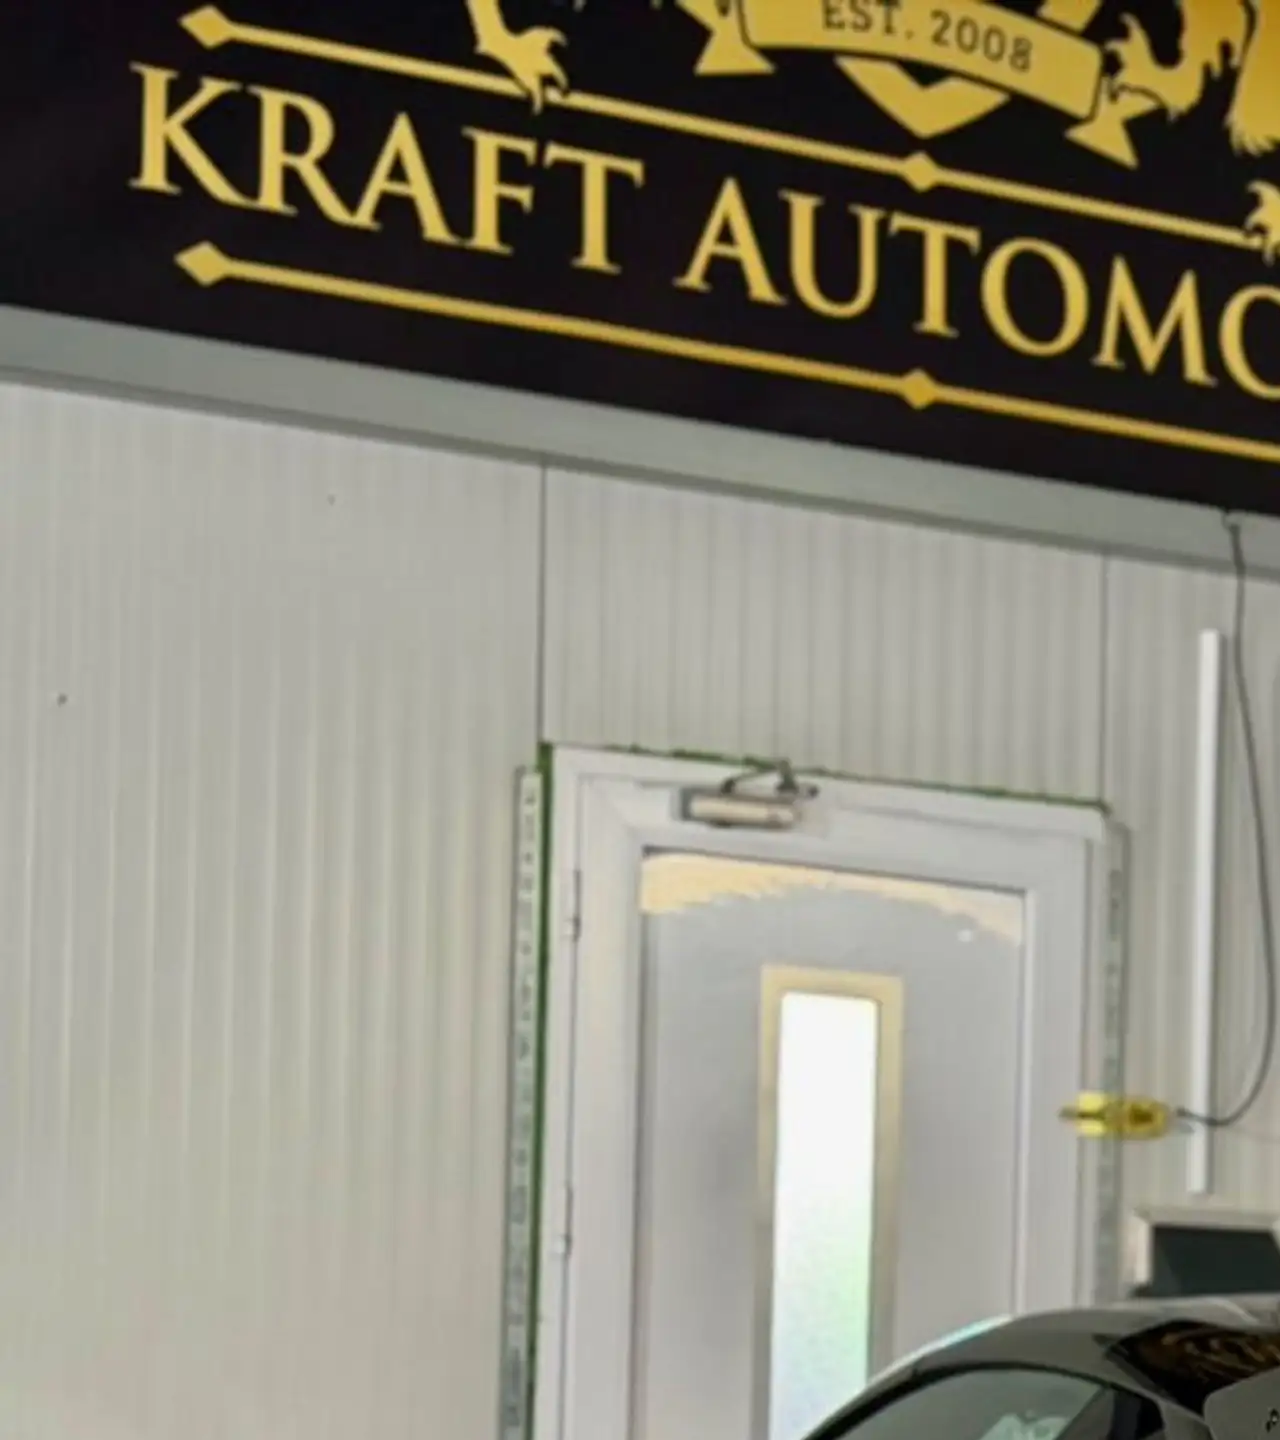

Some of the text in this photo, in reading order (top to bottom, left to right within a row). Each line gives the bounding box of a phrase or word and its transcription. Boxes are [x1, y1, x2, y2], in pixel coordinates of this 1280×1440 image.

[822, 0, 1033, 73] EST. 2008
[129, 61, 645, 274] KRAFT
